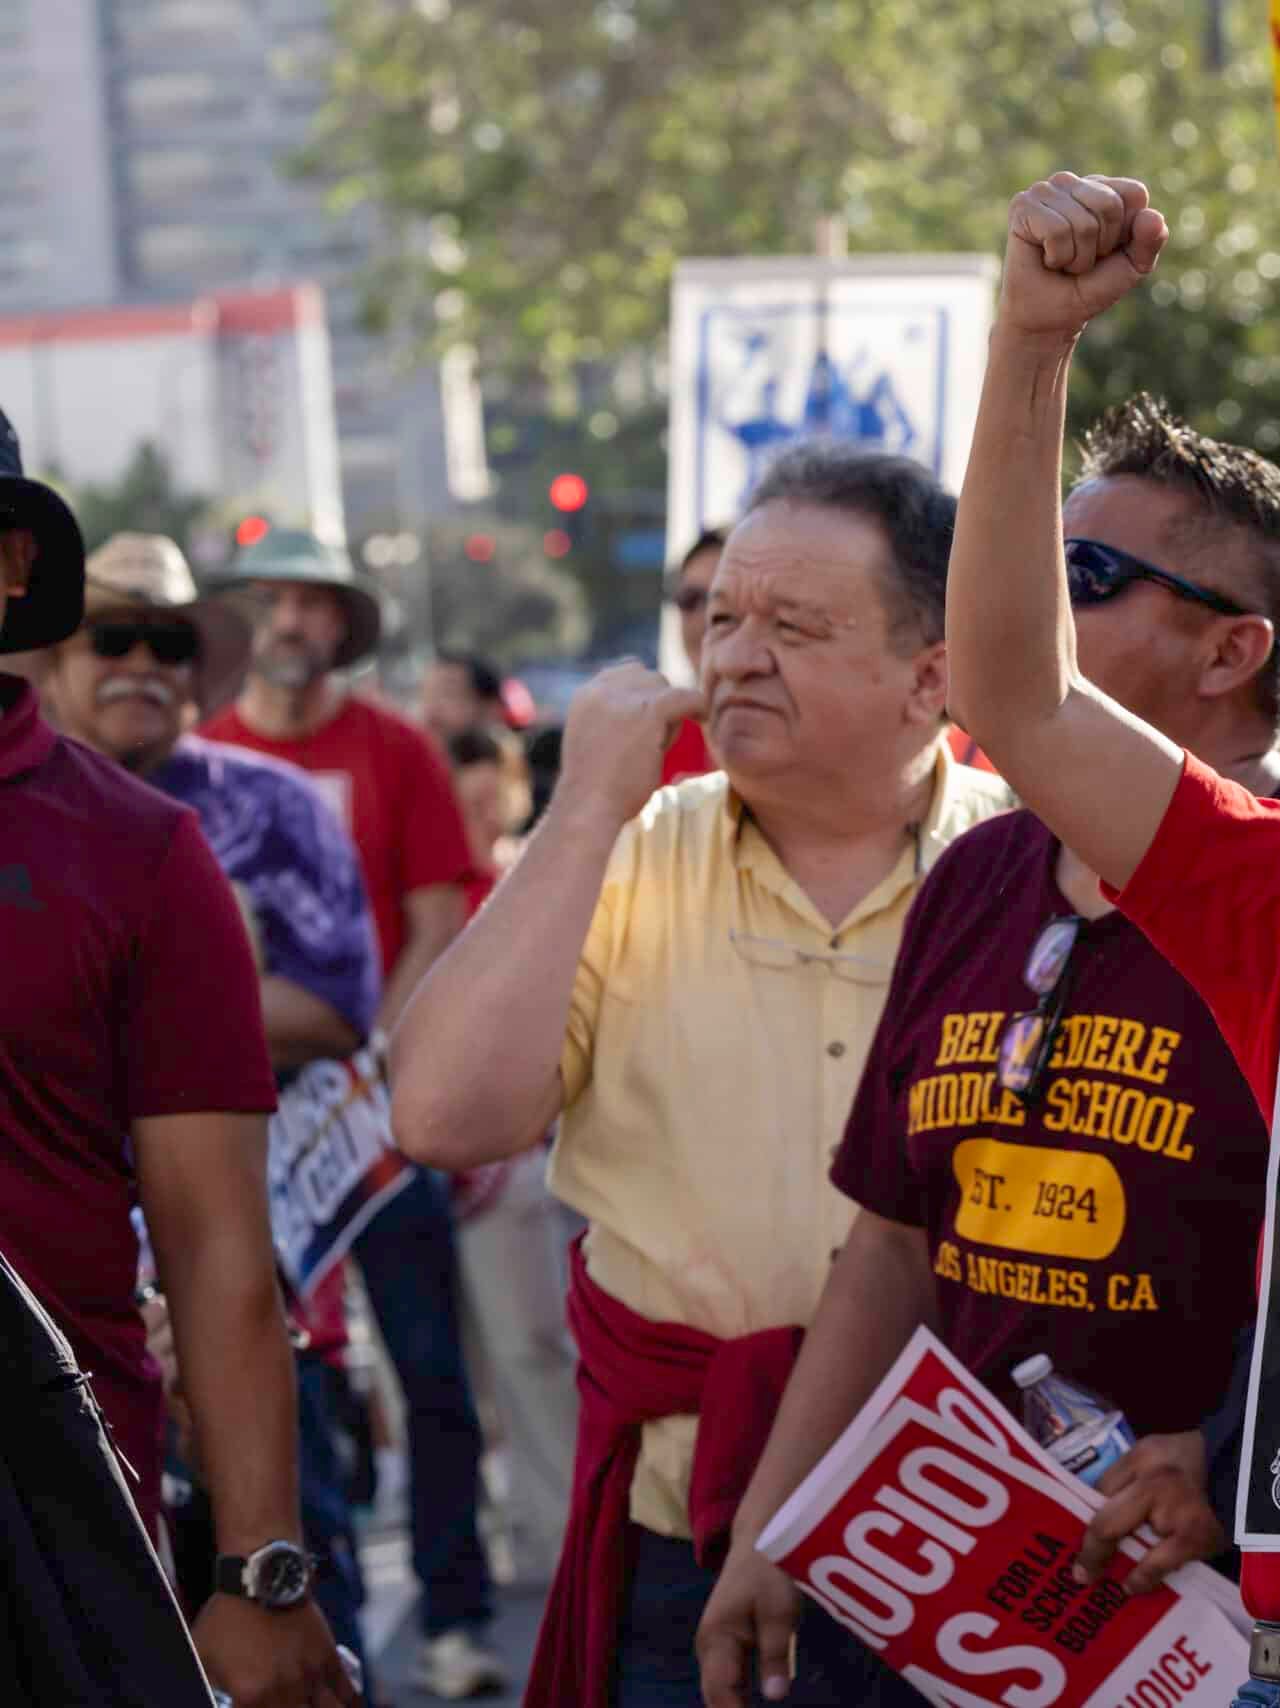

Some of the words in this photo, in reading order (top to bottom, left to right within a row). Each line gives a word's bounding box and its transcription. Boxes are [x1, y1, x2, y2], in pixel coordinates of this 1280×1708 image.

[907, 1072, 1025, 1136] MIDDLE
[1043, 1078, 1194, 1161] SCHOOL
[1032, 1181, 1098, 1223] 1924
[967, 1252, 1096, 1312] ANGELES,
[1107, 1274, 1159, 1311] CA
[986, 1560, 1043, 1613] FOR
[1023, 1533, 1067, 1568] LA
[1020, 1556, 1086, 1632] SCHO
[1055, 1579, 1128, 1653] BOARD
